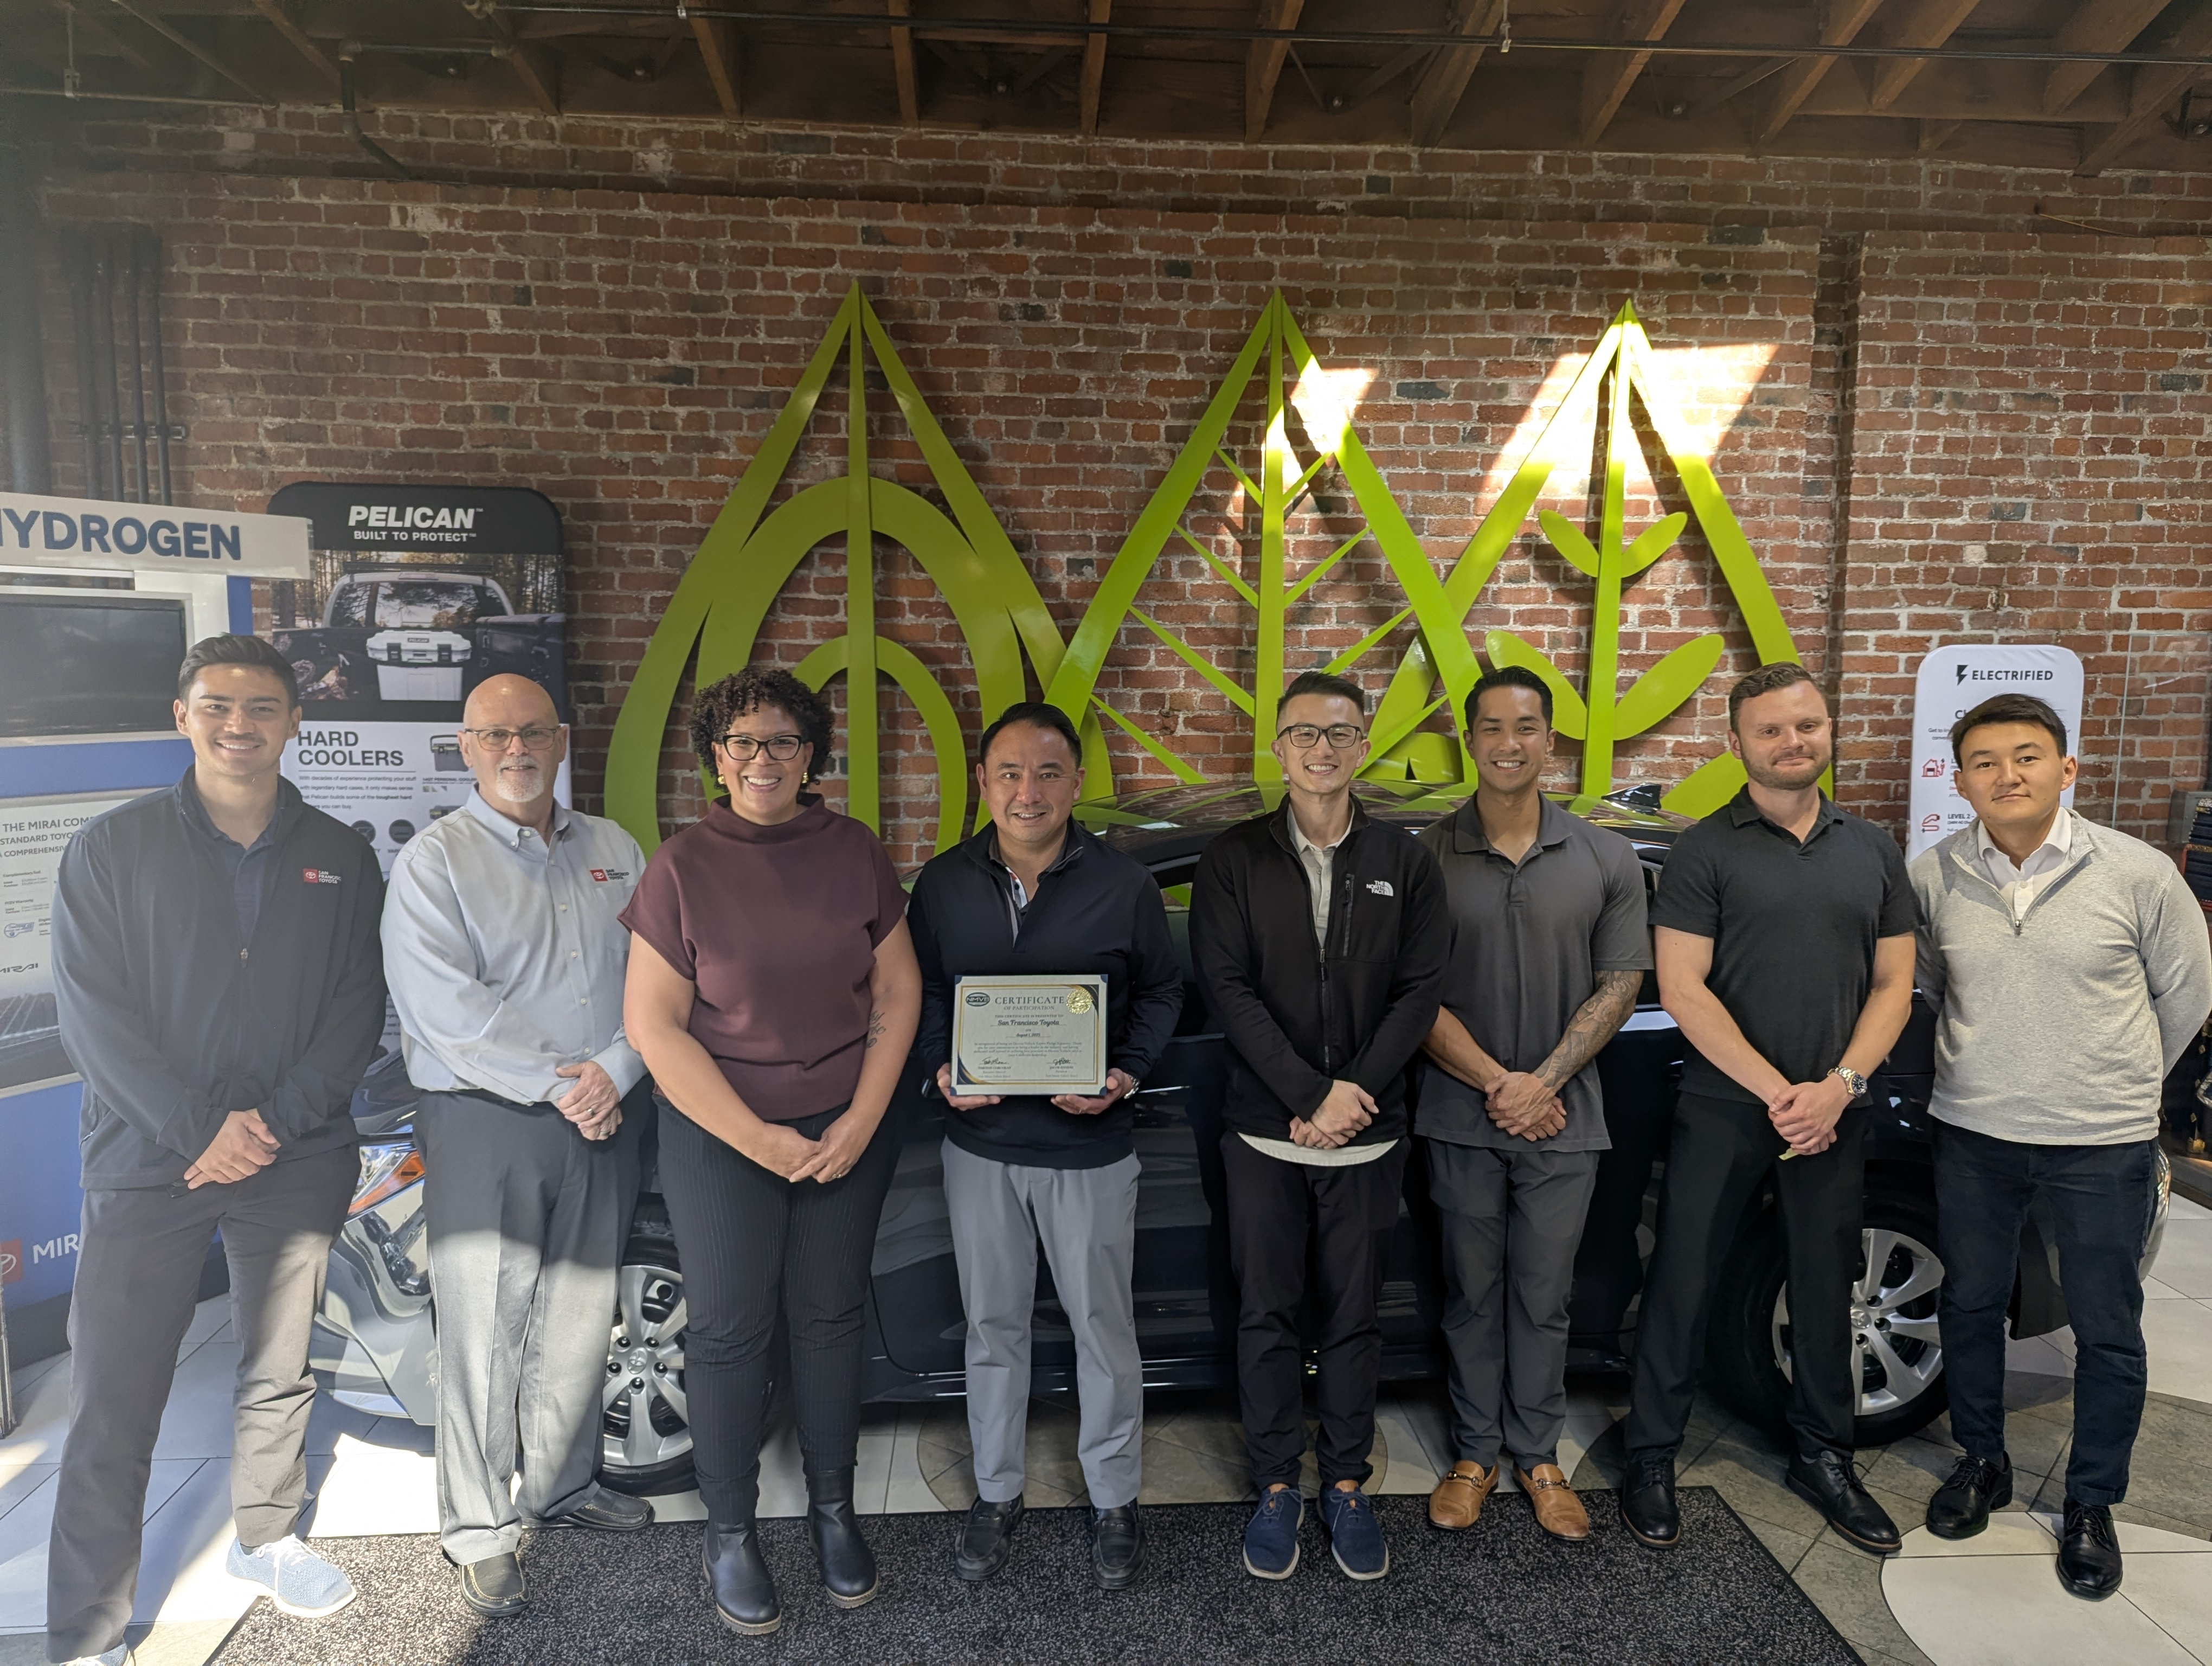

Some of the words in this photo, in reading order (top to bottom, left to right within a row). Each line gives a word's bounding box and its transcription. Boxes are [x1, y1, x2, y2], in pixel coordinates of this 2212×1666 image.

[0, 508, 241, 560] YDROGEN
[354, 530, 387, 540] BUILT
[392, 531, 408, 540] TO
[1972, 670, 2053, 681] ELECTRIFIED
[299, 731, 359, 747] HARD
[299, 749, 404, 766] COOLERS
[3, 822, 25, 832] THE
[28, 819, 60, 830] MIRAI
[63, 817, 94, 826] COM
[0, 835, 48, 845] STANDARD
[50, 832, 73, 840] TOYO
[1039, 1019, 1059, 1027] Toyota
[33, 1233, 79, 1264] MIR
